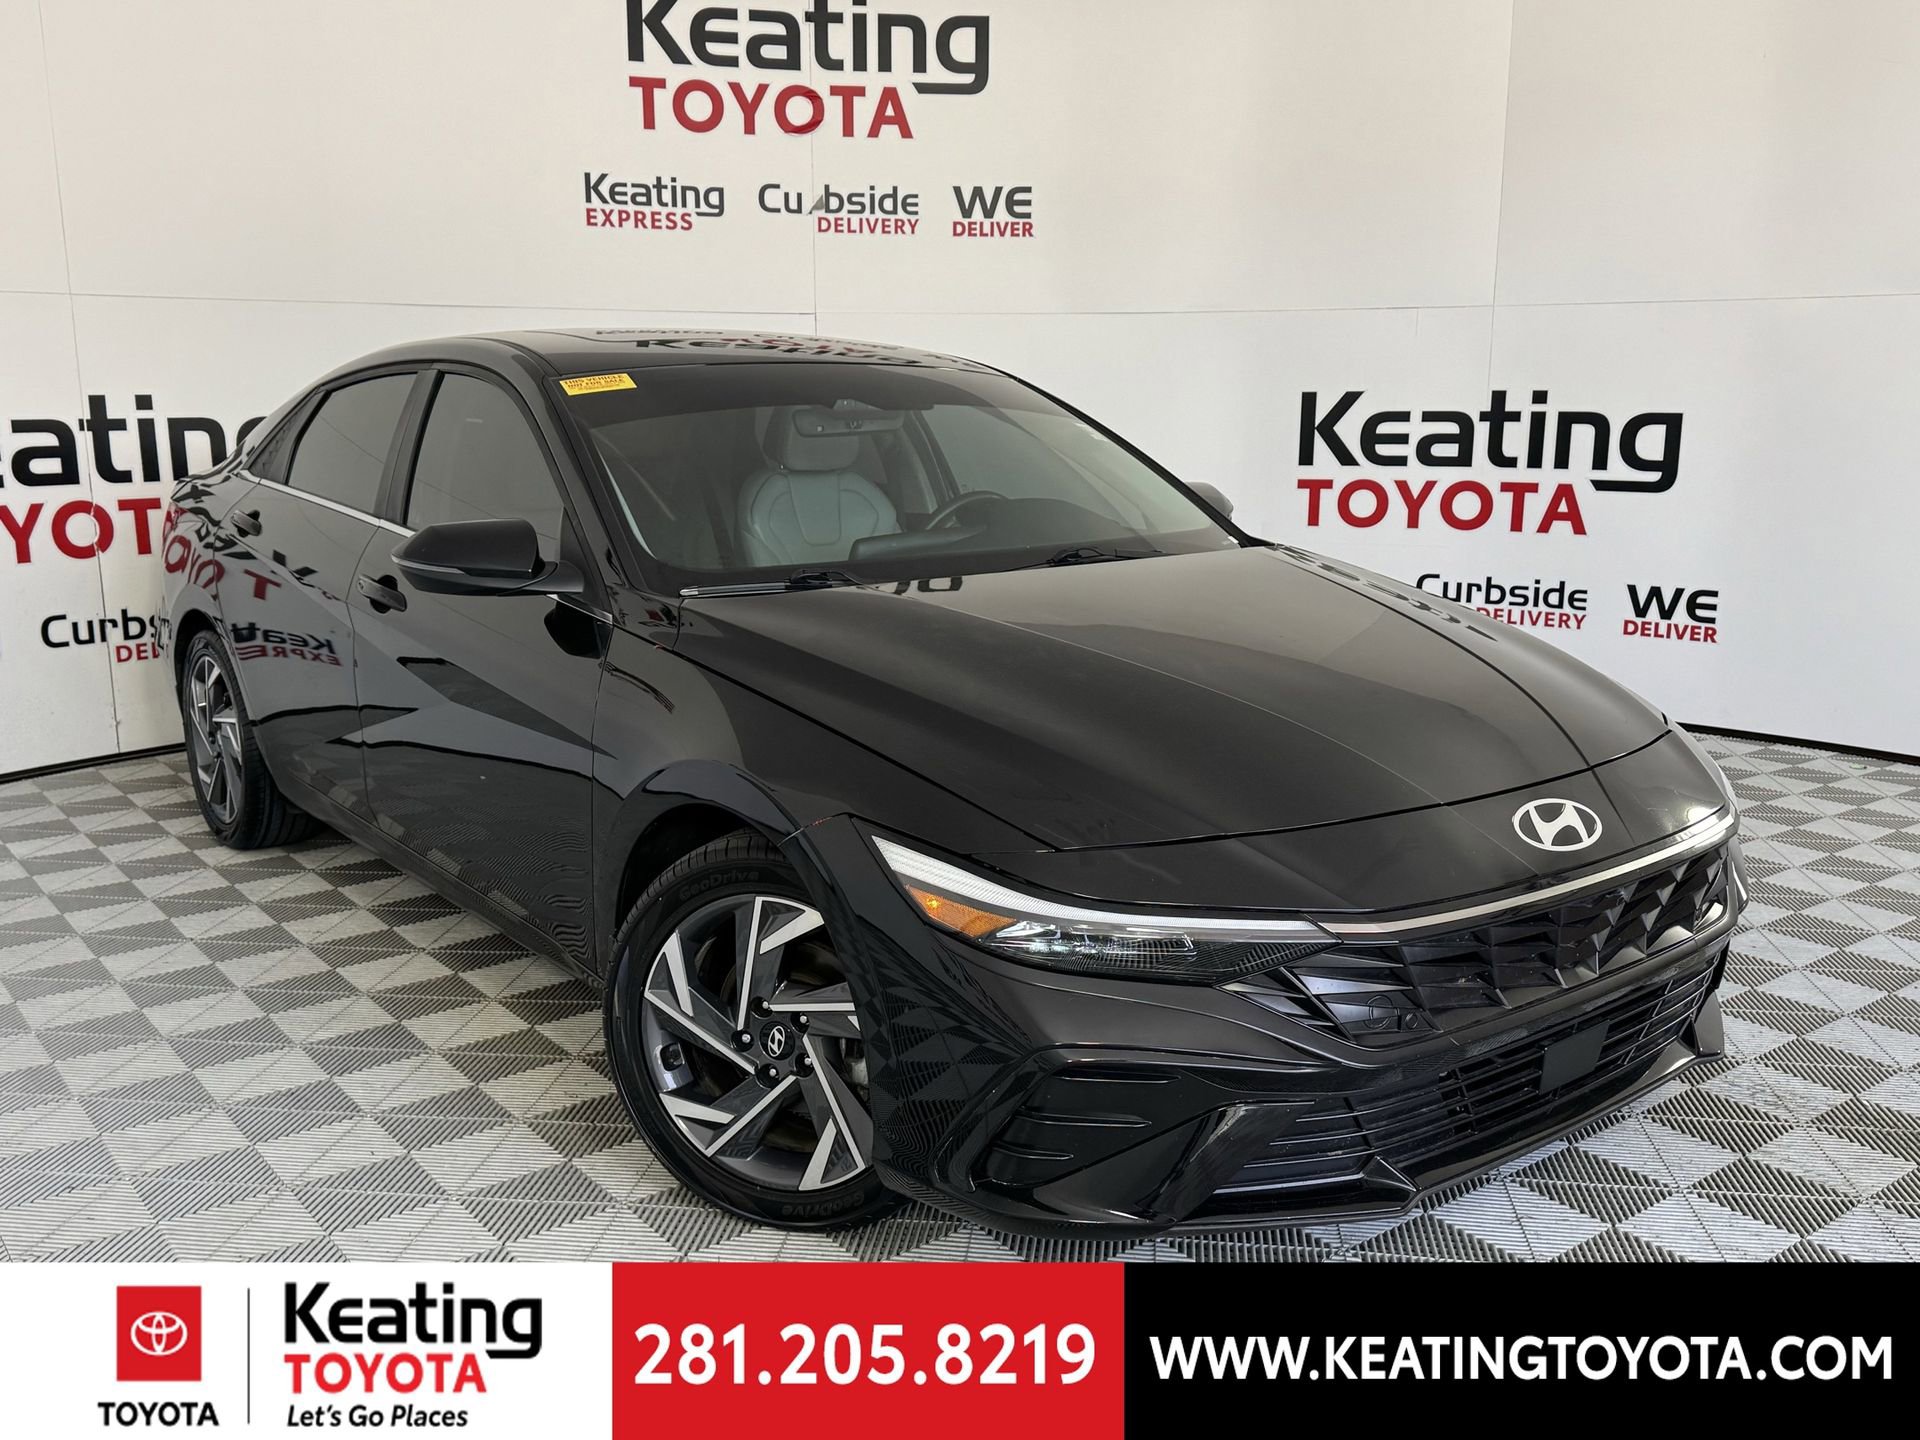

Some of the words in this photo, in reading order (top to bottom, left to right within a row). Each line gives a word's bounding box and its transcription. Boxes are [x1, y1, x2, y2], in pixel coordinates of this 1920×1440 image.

[626, 0, 990, 95] Keating
[628, 76, 914, 139] TOYOTA
[584, 172, 725, 217] Keating
[758, 183, 919, 216] Cubside
[952, 186, 1033, 219] WE
[585, 208, 693, 231] EXPRESS
[817, 216, 919, 235] DELIVERY
[952, 221, 1034, 238] DELIVER
[0, 394, 268, 486] atin
[1297, 389, 1684, 494] Keating
[1296, 478, 1587, 537] TOYOTA
[1625, 584, 1719, 624] WE
[1623, 619, 1717, 643] DELIVER
